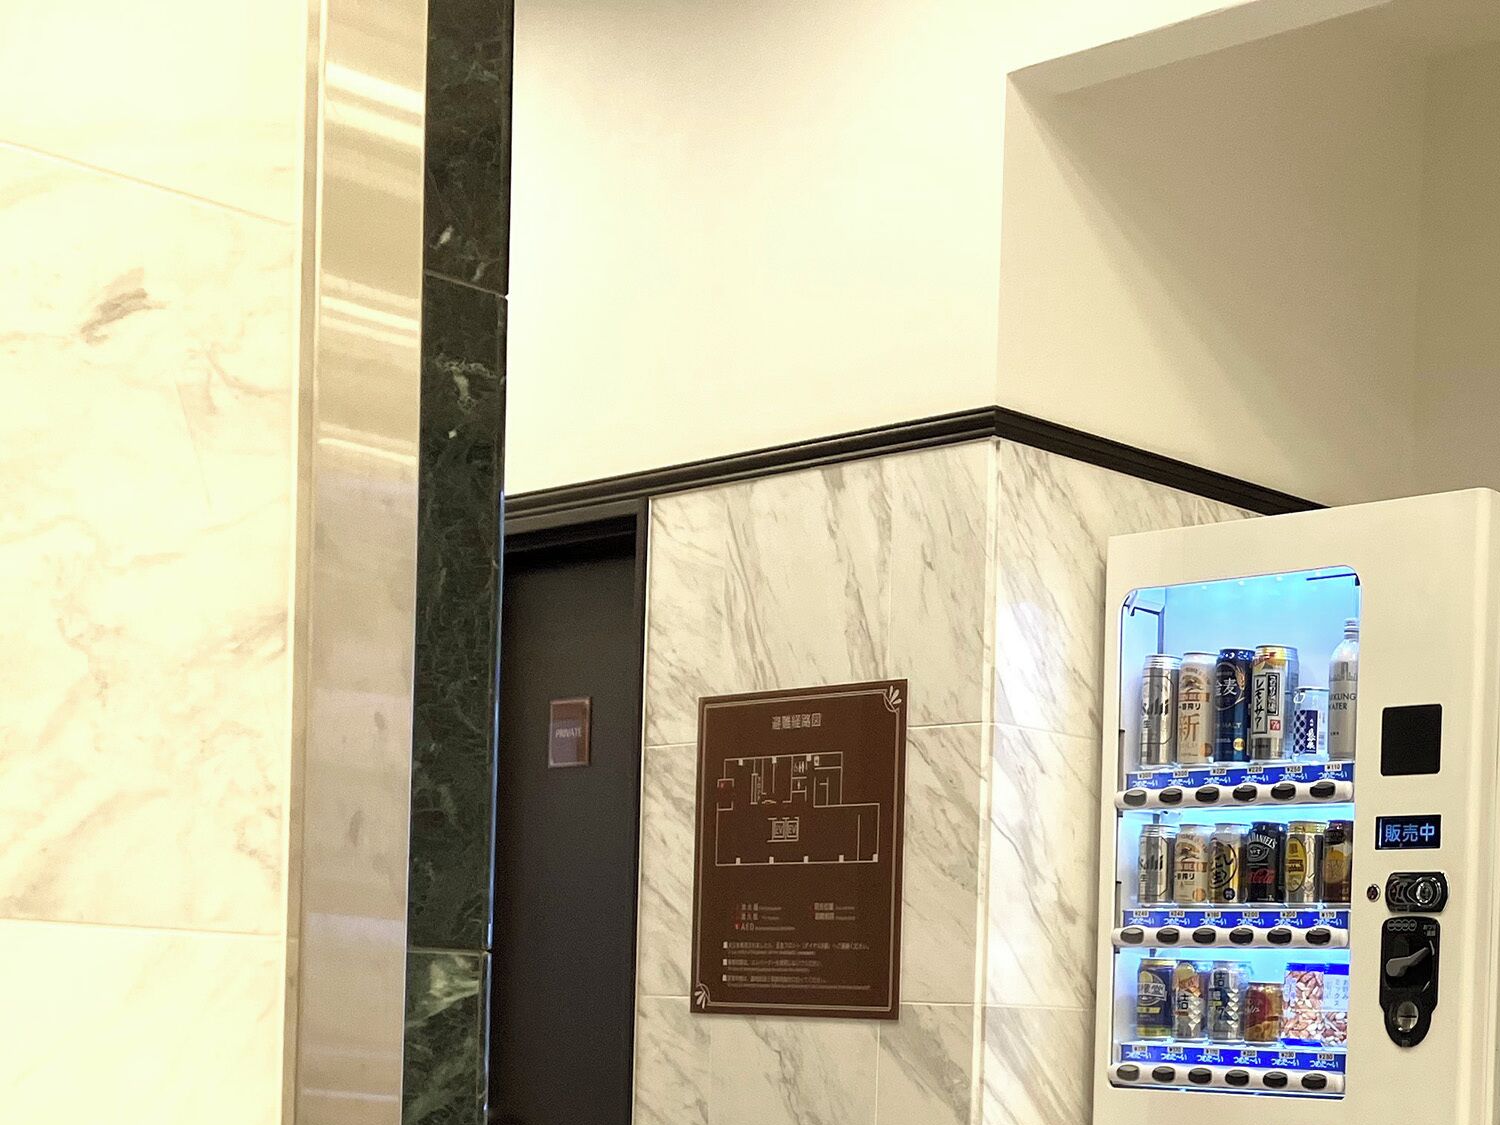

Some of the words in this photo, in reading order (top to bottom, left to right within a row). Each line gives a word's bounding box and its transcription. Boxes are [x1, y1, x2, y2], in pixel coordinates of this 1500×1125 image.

[772, 712, 821, 730] 避難経路図
[1384, 823, 1436, 843] 販売中
